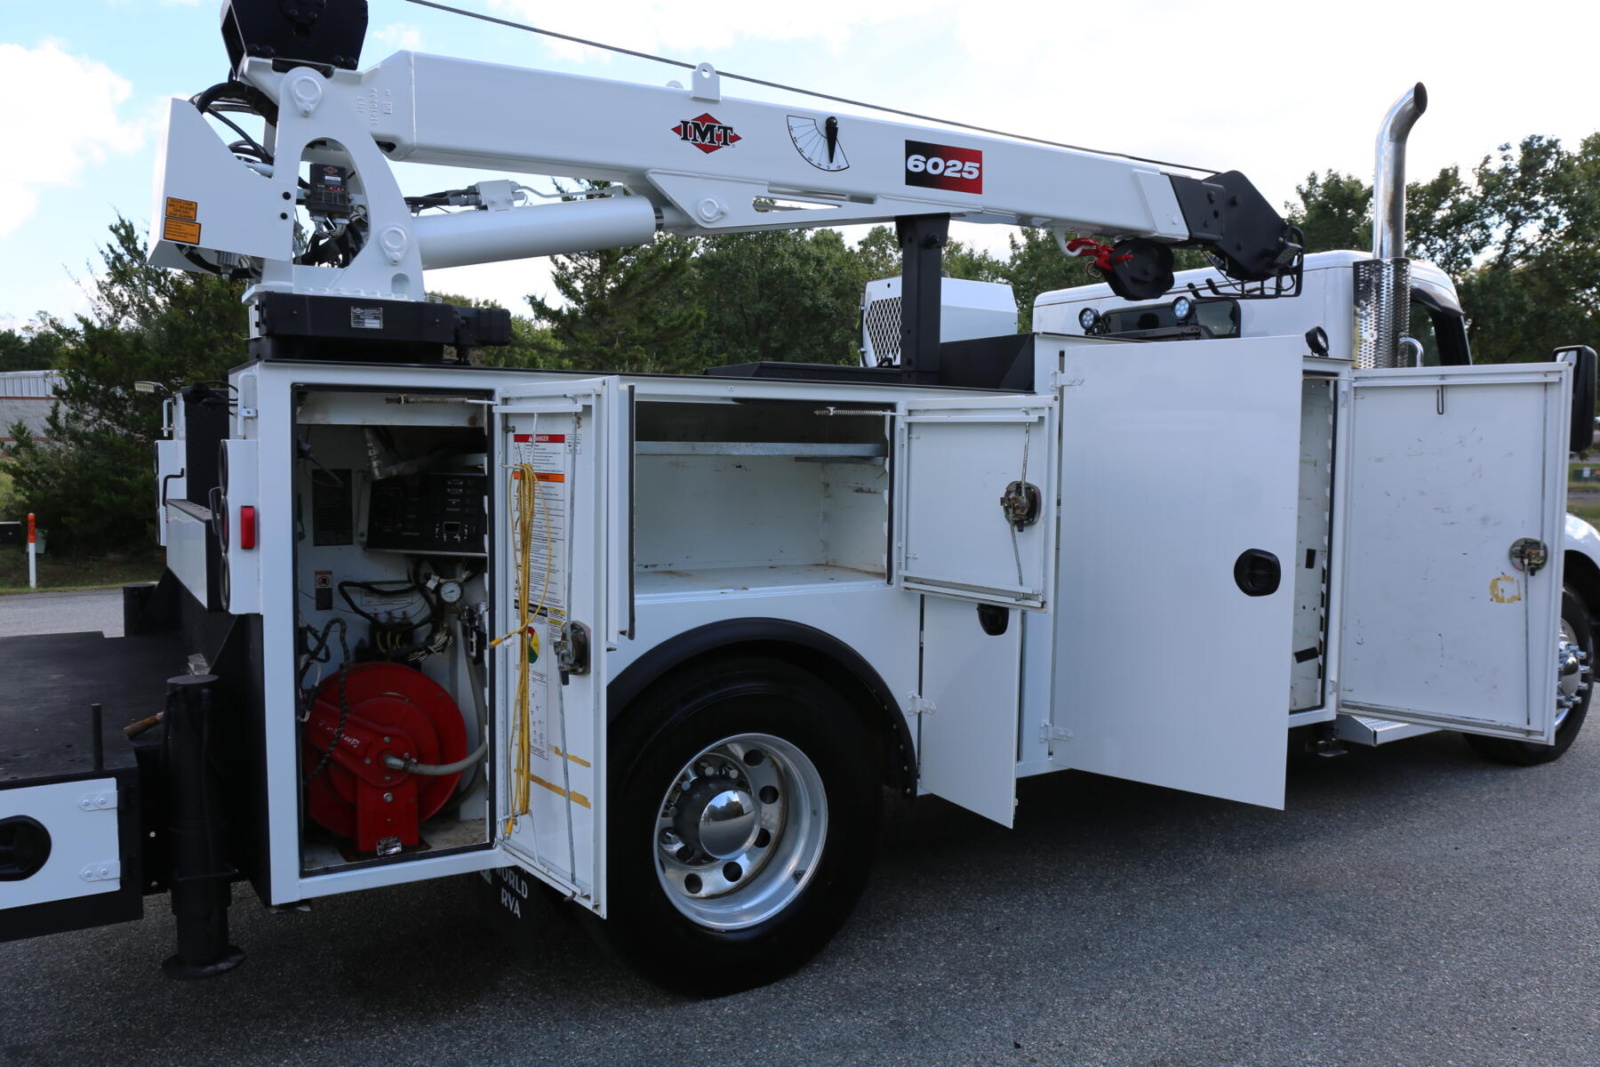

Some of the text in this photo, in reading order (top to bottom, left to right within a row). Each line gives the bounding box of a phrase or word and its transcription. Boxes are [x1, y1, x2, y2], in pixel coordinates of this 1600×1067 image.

[680, 120, 733, 146] IMT
[907, 154, 980, 180] 6025
[501, 887, 521, 919] RVA
